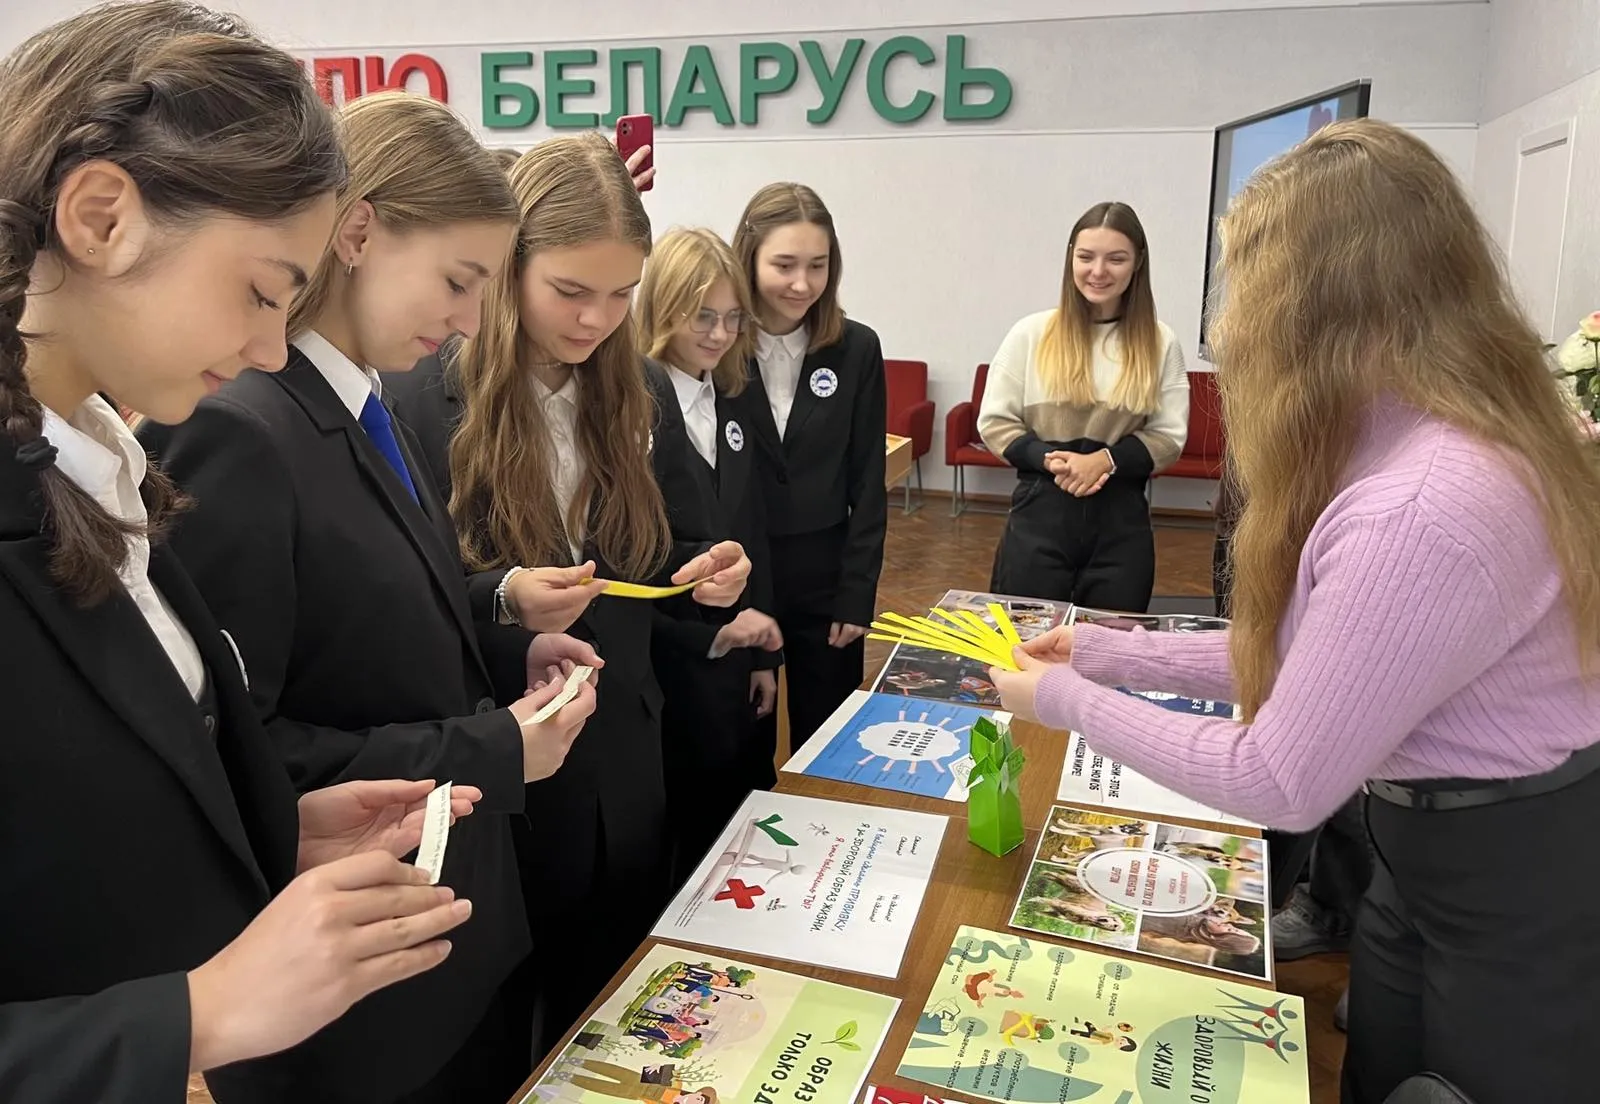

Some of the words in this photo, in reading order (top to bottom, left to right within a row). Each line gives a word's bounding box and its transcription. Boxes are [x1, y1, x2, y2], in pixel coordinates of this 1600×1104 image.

[304, 52, 448, 106] ЛЮ
[480, 34, 1013, 129] БЕЛАРУСЬ
[888, 730, 908, 747] ЖИЗНИ
[901, 732, 921, 748] ОБРАЗ
[911, 728, 938, 756] ЗДОРОВЫЙ
[1072, 758, 1084, 776] МИРЕ!
[1091, 769, 1101, 778] НО
[1108, 790, 1119, 798] НЕ
[1109, 779, 1120, 789] ЭТО
[839, 838, 864, 876] ЗДОРОВЫЙ
[802, 894, 816, 909] ТЫ?
[825, 876, 846, 902] ОБРАЗ
[809, 902, 833, 932] ЖИЗНИ.
[831, 888, 861, 932] ПРИВИВКУ,
[771, 1032, 812, 1080] ТОЛЬКО
[1151, 1041, 1174, 1089] ЖИЗНИ
[1192, 1014, 1216, 1092] ЗДОРОВЫЙ
[794, 1057, 832, 1102] ОБРАЗ
[991, 1051, 1007, 1087] продуктов
